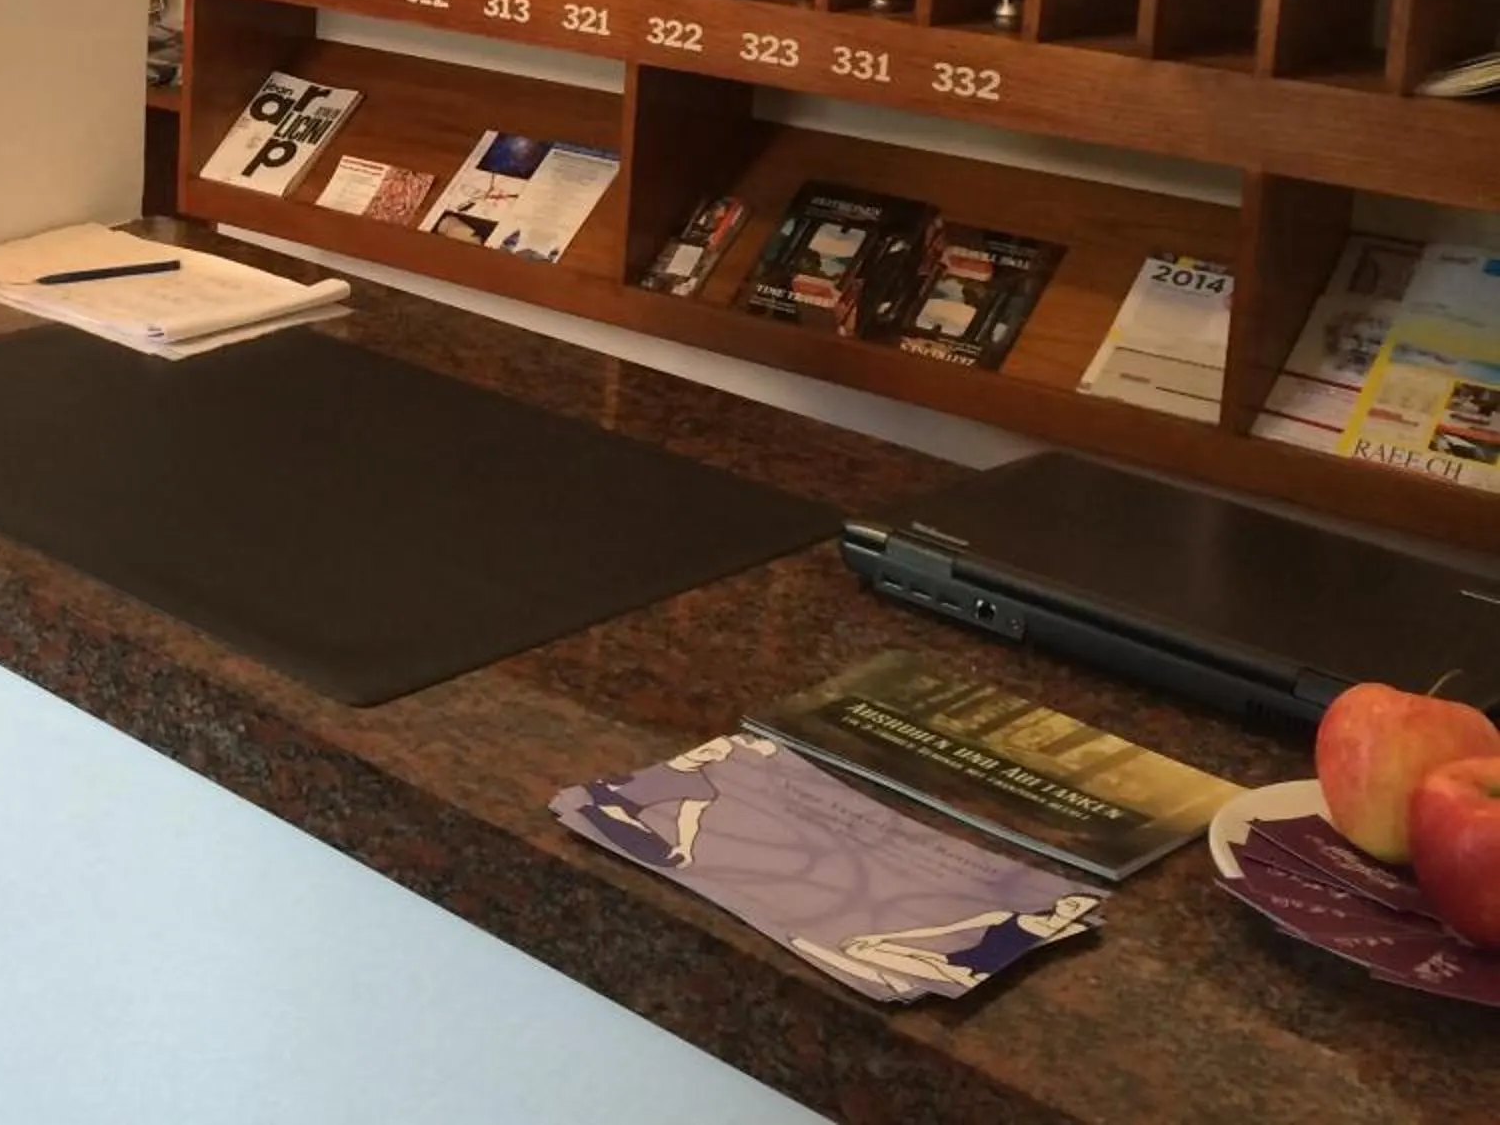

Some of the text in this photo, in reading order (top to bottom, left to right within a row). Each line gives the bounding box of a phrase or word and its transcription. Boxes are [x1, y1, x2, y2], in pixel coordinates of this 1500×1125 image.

[561, 3, 611, 36] 321
[646, 17, 703, 52] 322
[739, 32, 799, 68] 323
[831, 46, 891, 82] 331
[931, 62, 1001, 101] 332
[1150, 264, 1226, 294] 2014
